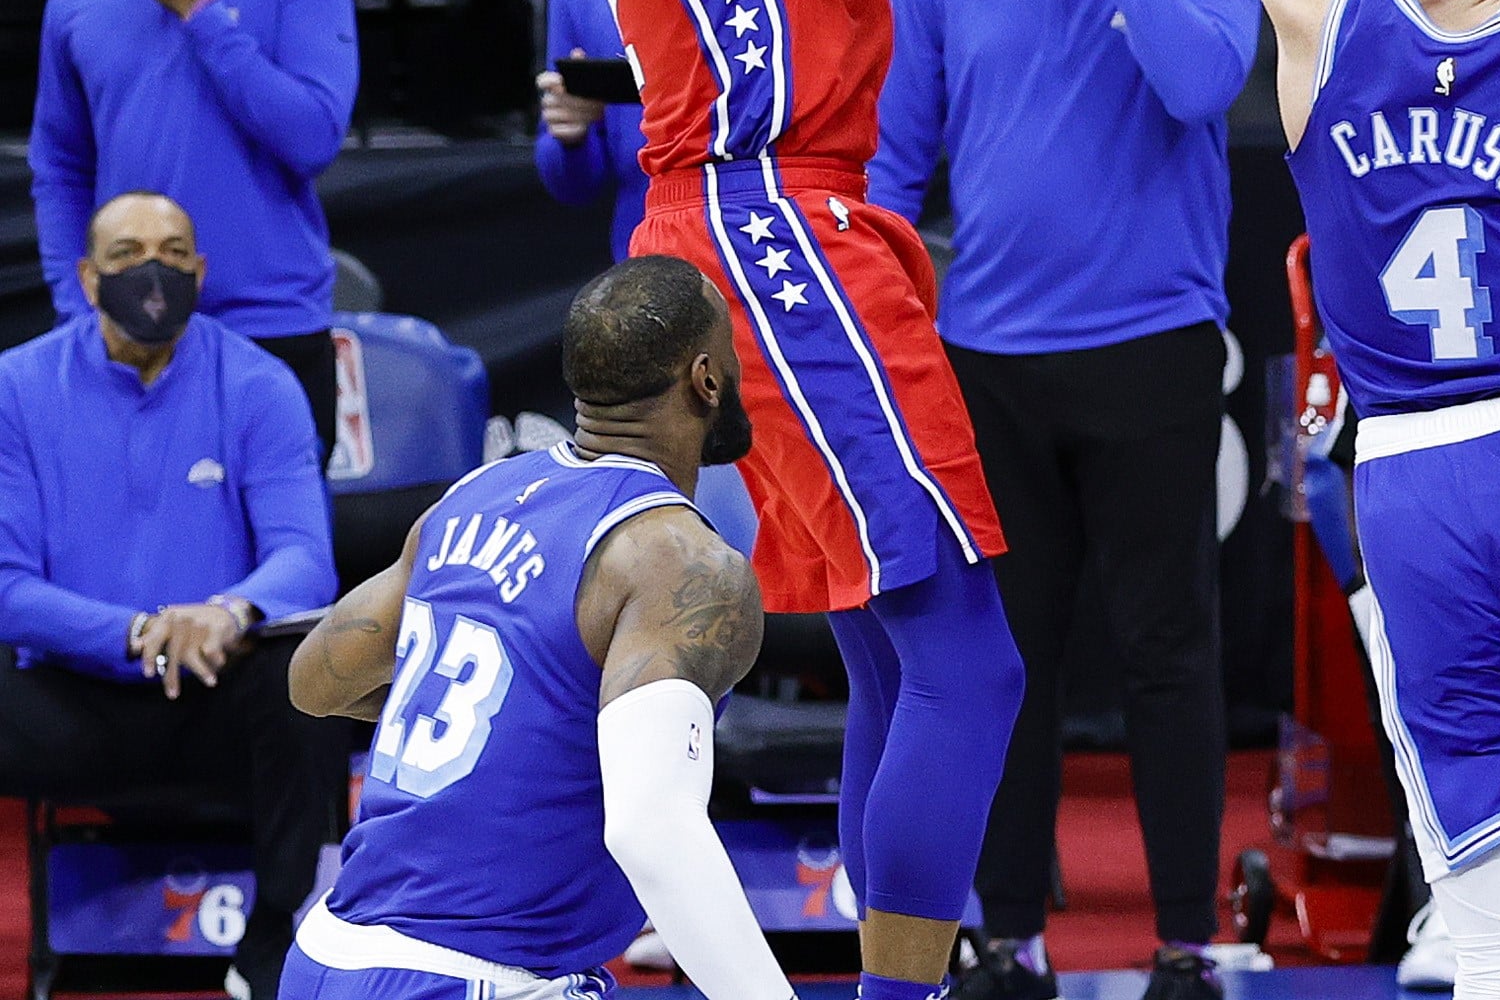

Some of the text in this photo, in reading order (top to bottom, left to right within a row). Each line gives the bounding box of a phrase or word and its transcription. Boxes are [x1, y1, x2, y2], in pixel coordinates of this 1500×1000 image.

[1377, 203, 1495, 363] 4
[427, 513, 546, 603] JAMES
[369, 595, 514, 799] 23
[163, 884, 246, 947] 76
